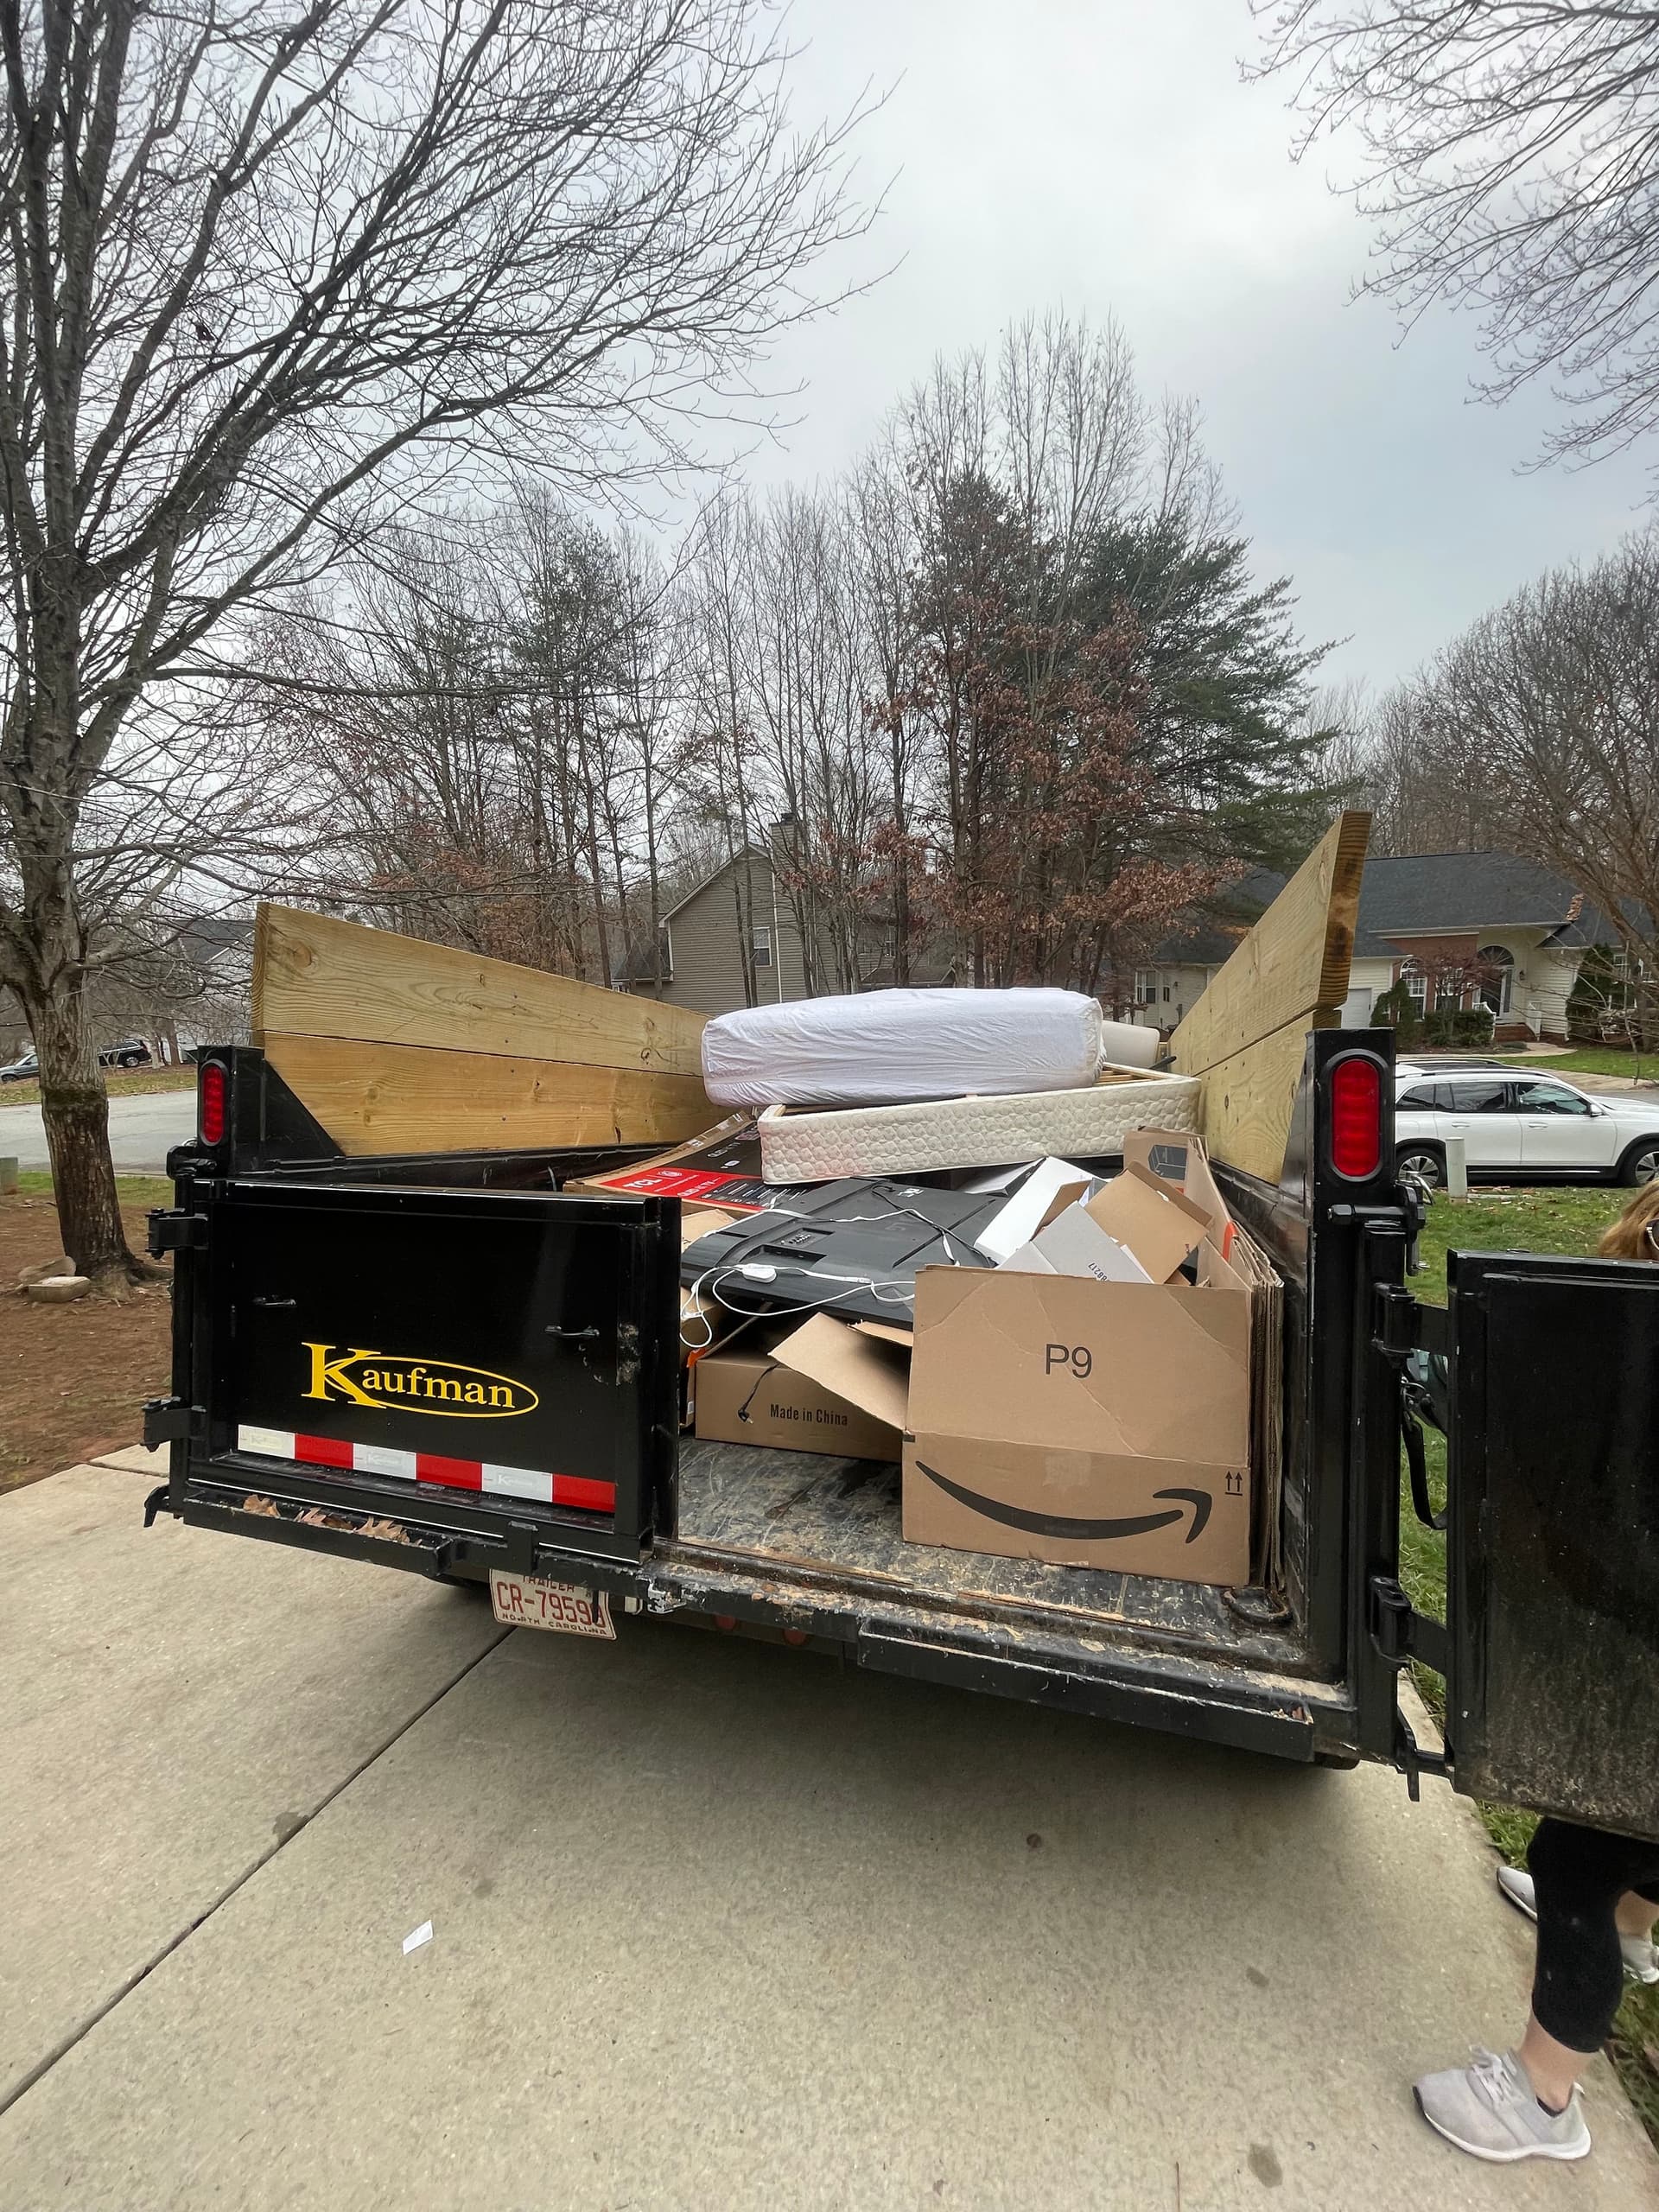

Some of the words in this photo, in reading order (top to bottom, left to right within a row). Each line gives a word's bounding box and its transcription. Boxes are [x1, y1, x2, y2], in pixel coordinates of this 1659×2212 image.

[622, 1179, 662, 1189] TCL
[1046, 1344, 1092, 1378] P9
[302, 1342, 516, 1409] Kaufman
[770, 1403, 799, 1421] Made
[802, 1407, 813, 1422] in
[816, 1408, 848, 1426] China
[548, 1621, 607, 1635] CAROLINA
